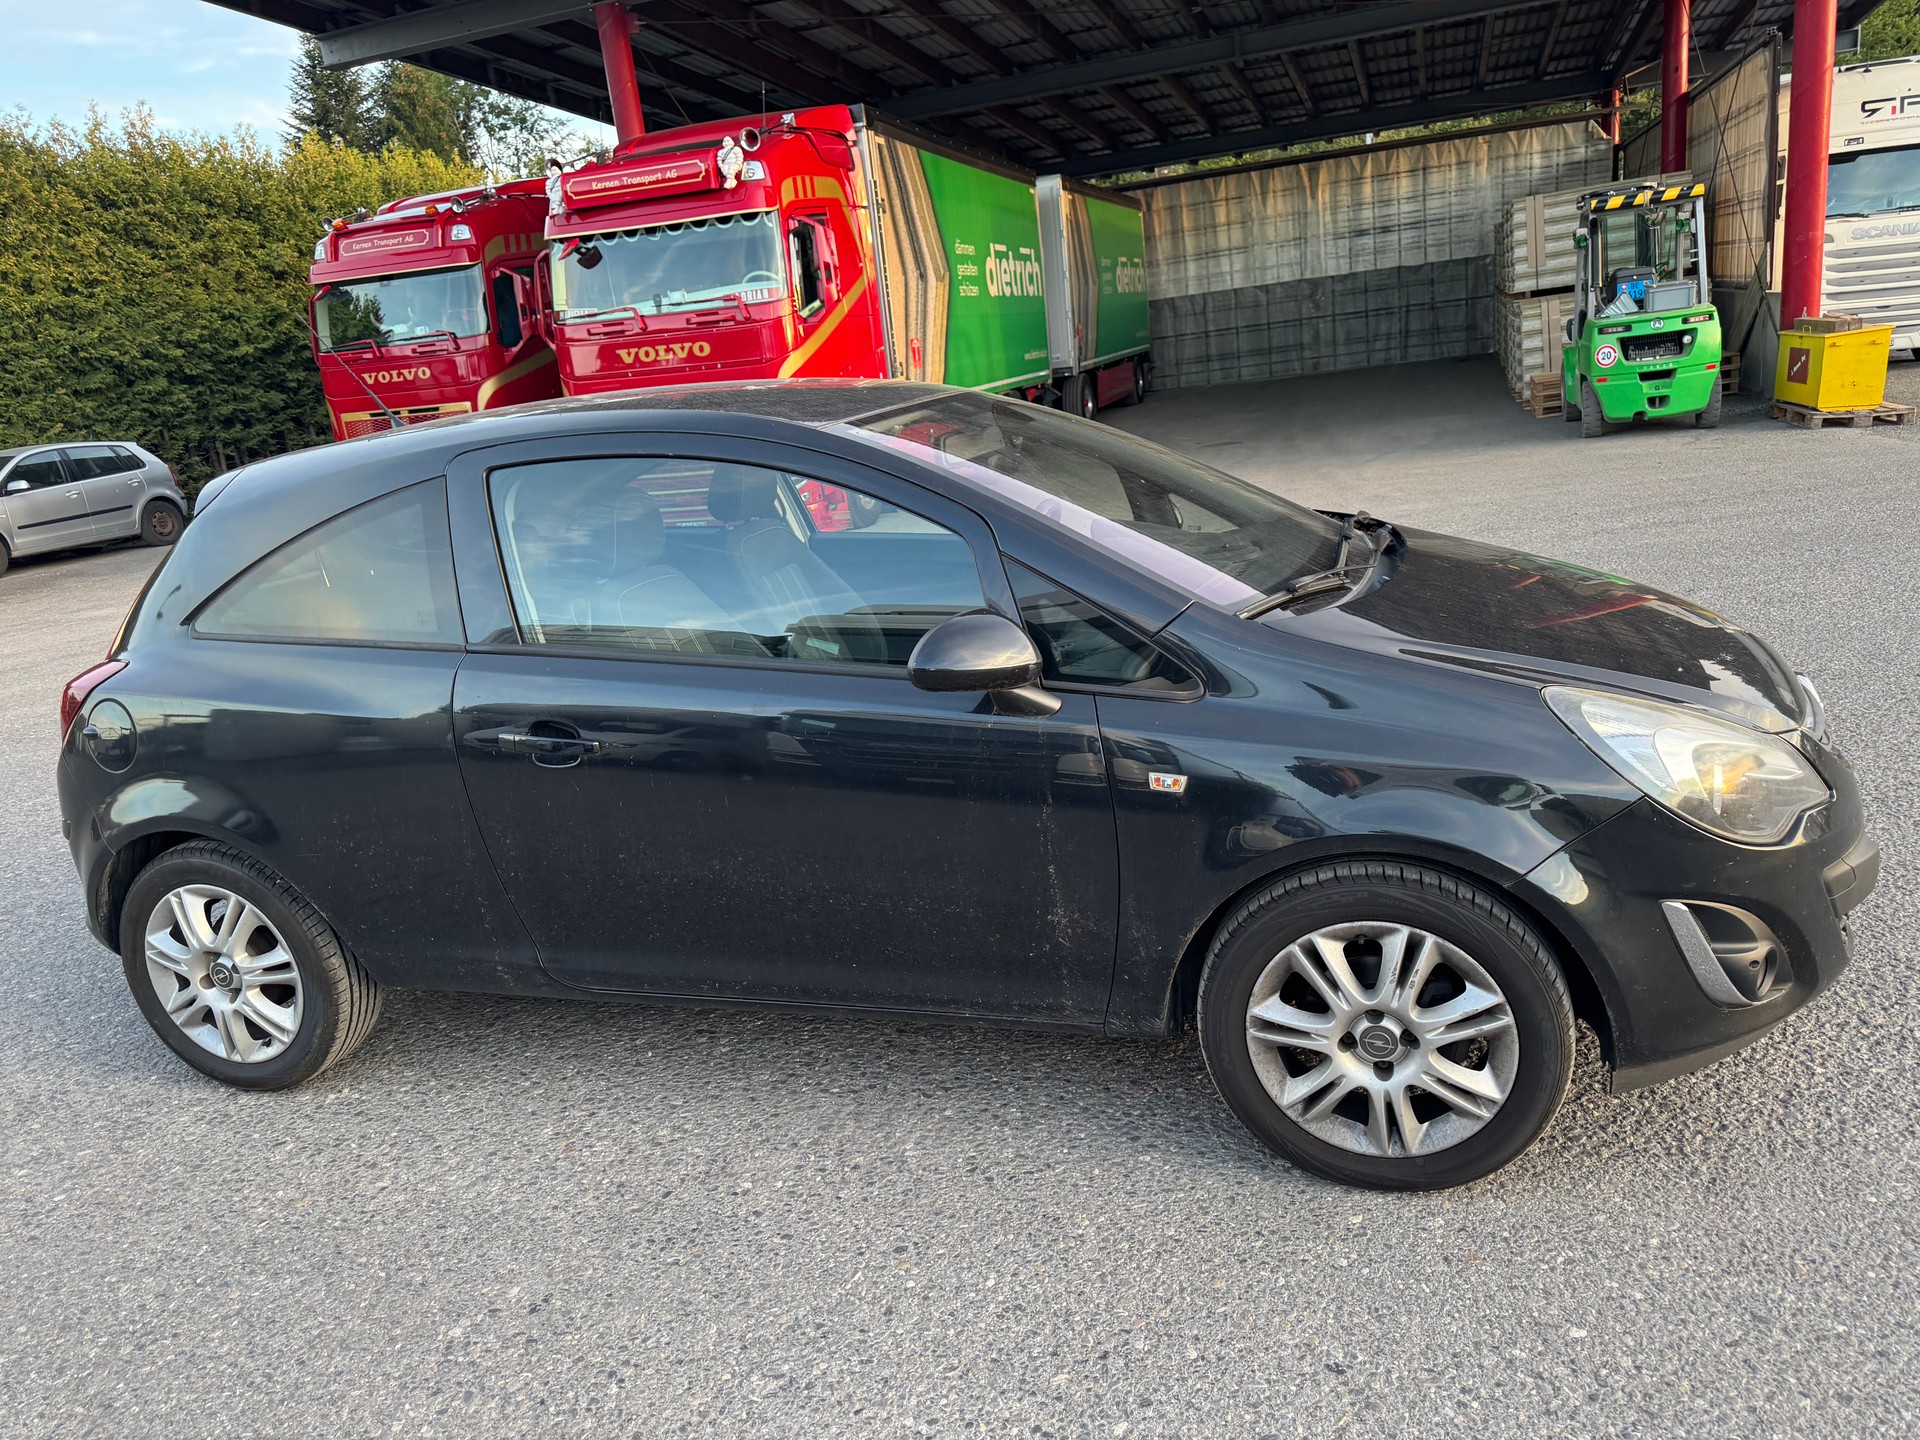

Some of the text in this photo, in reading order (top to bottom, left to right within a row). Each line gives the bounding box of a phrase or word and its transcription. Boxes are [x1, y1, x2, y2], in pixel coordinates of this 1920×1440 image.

[591, 169, 678, 191] Kernen Transport AG
[1851, 222, 1920, 241] SCANIA
[352, 241, 372, 250] Kernen
[374, 237, 402, 247] Transport
[985, 242, 1043, 298] dietrich
[1116, 256, 1146, 294] dietrich
[735, 288, 769, 302] DRIAN
[615, 341, 711, 364] VOLVO
[1601, 351, 1612, 360] 20
[361, 366, 431, 385] VOLVO
[1378, 897, 1427, 914] OUTSIDE
